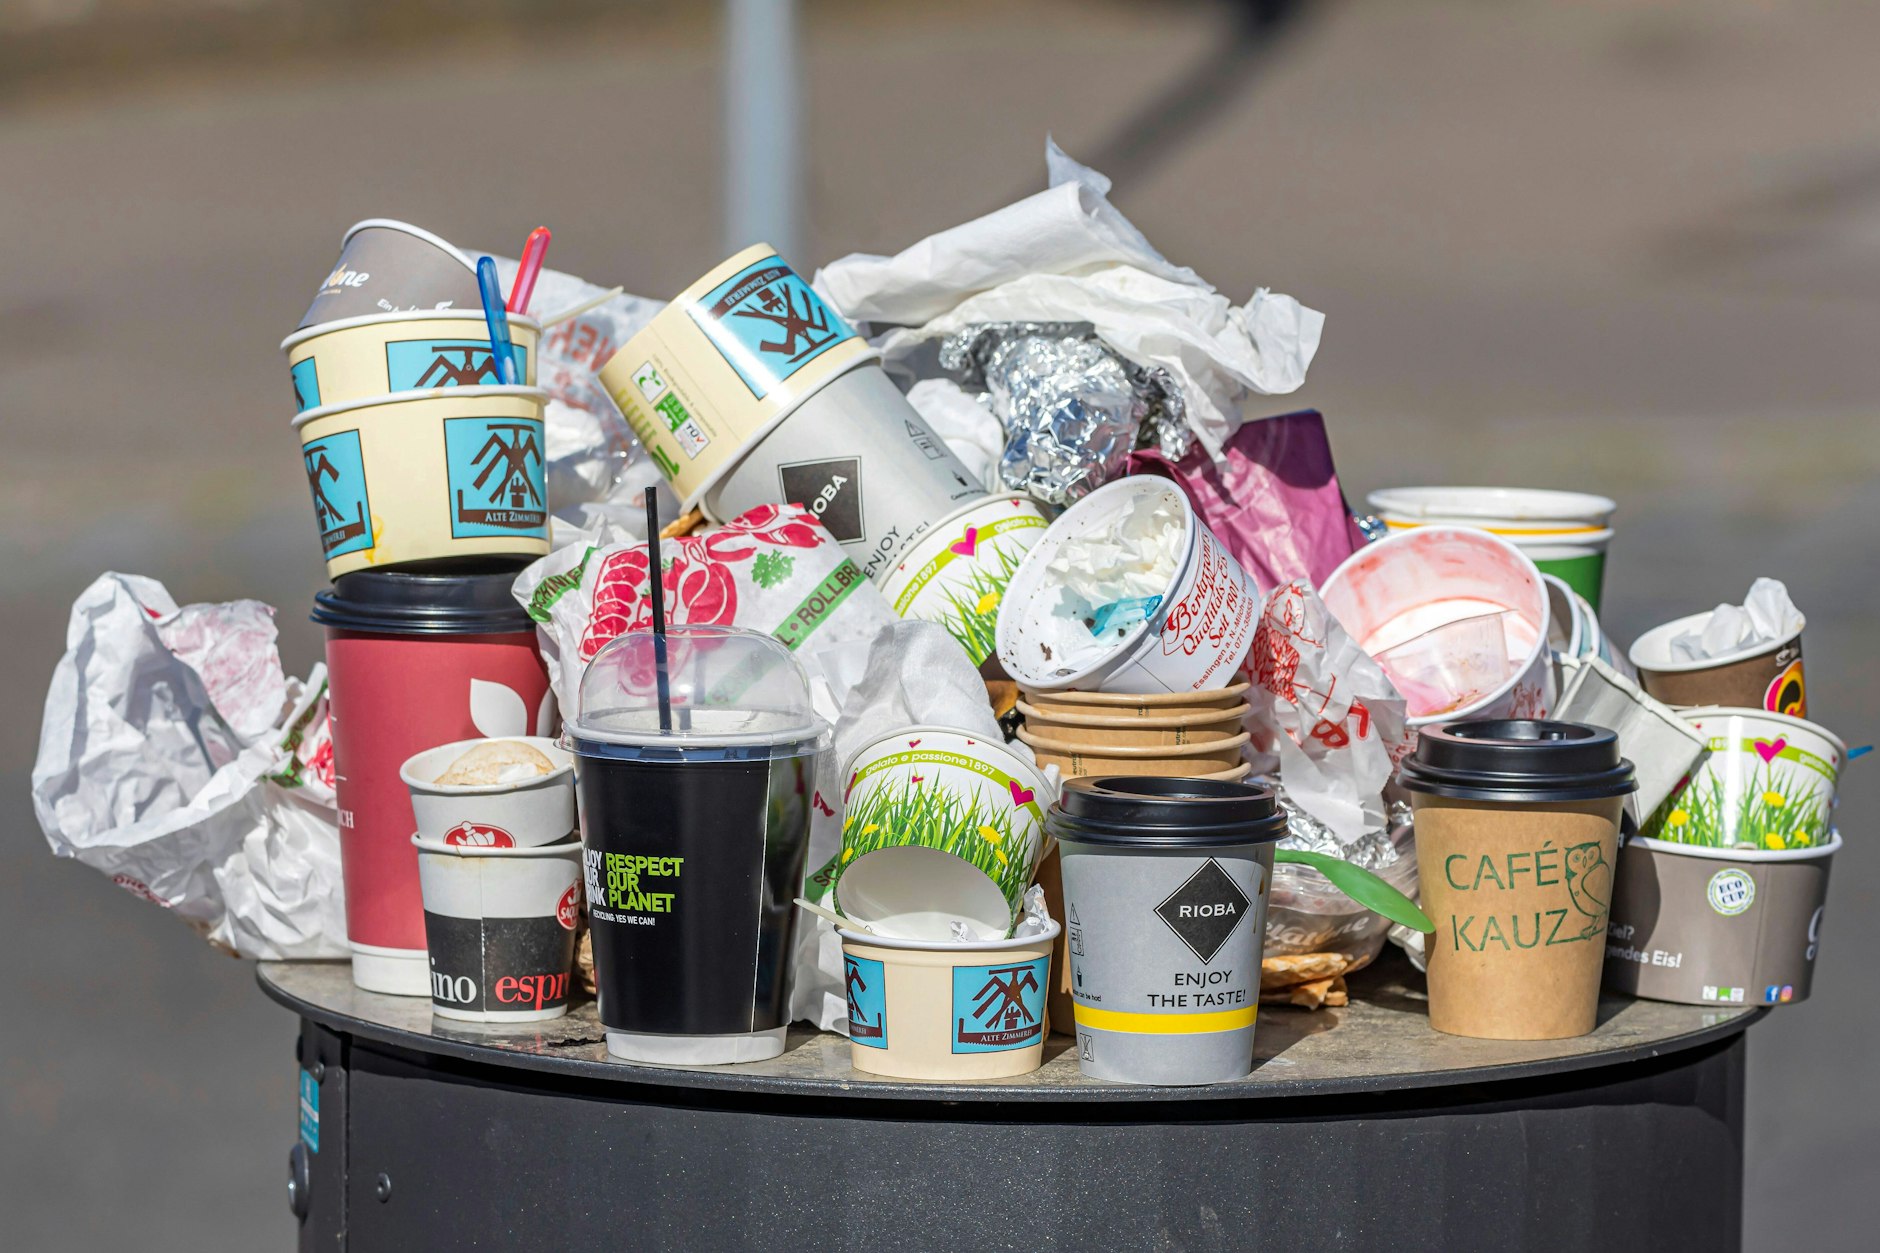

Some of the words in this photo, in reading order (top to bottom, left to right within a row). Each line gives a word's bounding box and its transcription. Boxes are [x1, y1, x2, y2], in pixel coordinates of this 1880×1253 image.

[808, 473, 848, 520] IOBA
[484, 511, 507, 522] ALTE
[863, 525, 901, 579] ENJOY
[1223, 650, 1238, 666] Tel.
[1192, 648, 1227, 690] Esslingen
[865, 756, 898, 777] gelato
[900, 754, 909, 762] e
[585, 848, 602, 870] JOY
[605, 852, 685, 877] RESPECT
[1445, 840, 1559, 891] CAFÉ
[586, 866, 599, 887] UR
[607, 870, 640, 893] OUR
[1718, 880, 1744, 894] ECO
[608, 888, 676, 913] PLANET
[1721, 890, 1746, 905] CUP
[615, 914, 627, 924] YES
[627, 916, 638, 925] WE
[638, 917, 656, 926] CAN!
[1179, 902, 1236, 918] RIOBA
[1451, 908, 1568, 952] KAUZ
[1652, 949, 1683, 969] Eis!
[1174, 970, 1233, 989] ENJOY
[1147, 994, 1188, 1007] THE
[1193, 989, 1246, 1007] TASTE!
[980, 1034, 1000, 1042] ALTE
[1001, 1029, 1033, 1041] ZIMMEREI
